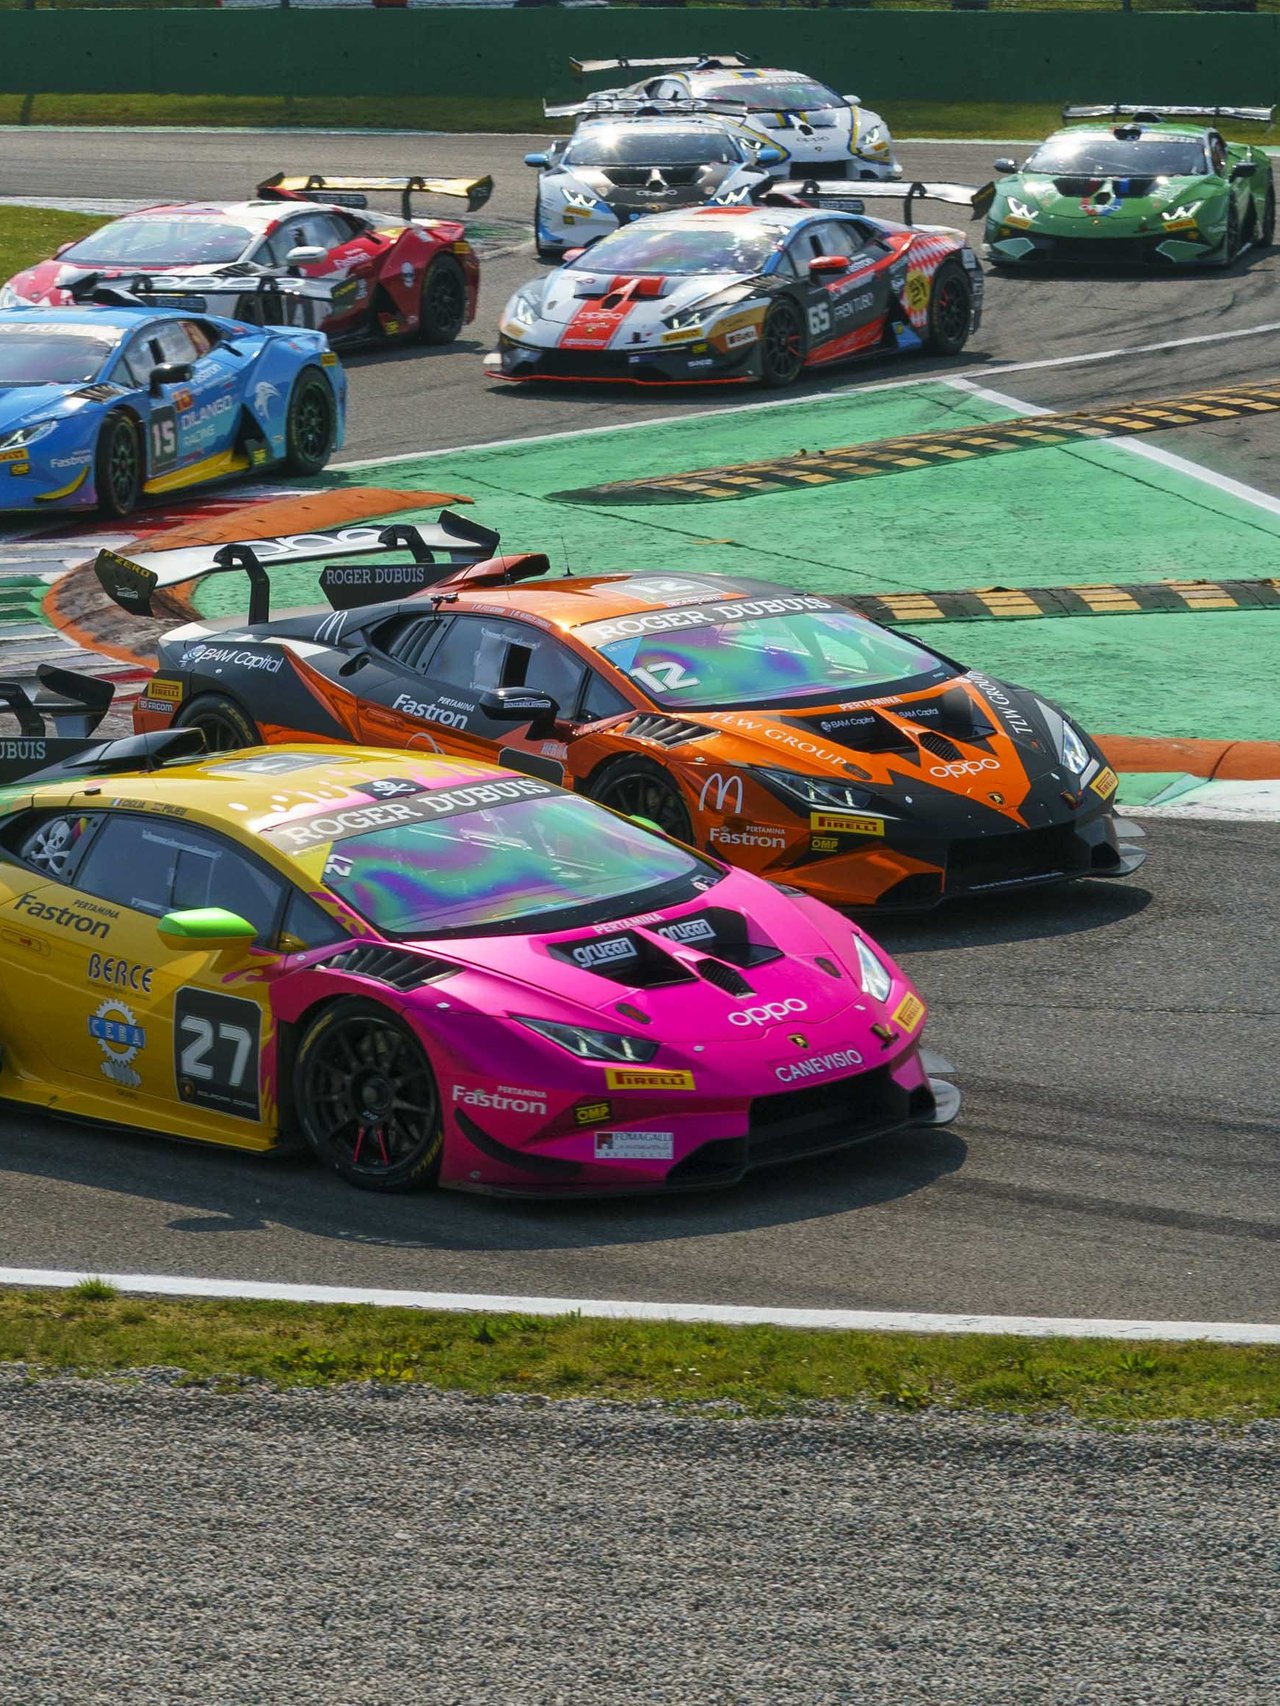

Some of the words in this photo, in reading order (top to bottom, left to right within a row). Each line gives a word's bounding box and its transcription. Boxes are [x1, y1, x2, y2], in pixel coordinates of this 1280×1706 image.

[578, 311, 622, 320] oppo
[808, 302, 830, 335] 65
[152, 419, 176, 457] 15
[115, 556, 151, 579] ZERO
[326, 568, 372, 585] ROGER
[375, 567, 425, 584] DUBUIS
[592, 609, 716, 640] ROGER
[711, 596, 833, 620] DUBUIS
[198, 648, 233, 664] BAM
[234, 651, 285, 674] Capital
[630, 661, 701, 694] 12
[152, 684, 180, 698] PIRELLI
[839, 694, 904, 712] PERTAMINA
[392, 693, 468, 730] Fastron
[437, 695, 476, 713] PERTAMINA
[831, 719, 850, 729] BAM
[851, 716, 876, 728] Capital
[916, 706, 940, 717] Capital
[708, 711, 763, 731] TLW
[764, 728, 848, 767] GROUP
[929, 756, 1001, 779] oppo
[279, 801, 424, 847] ROGER
[416, 778, 554, 817] DUBUIS
[818, 815, 878, 832] PIRELLI
[709, 827, 786, 849] Fastron
[746, 825, 786, 836] PERTAMINA
[812, 838, 840, 850] OMP
[324, 853, 354, 880] 27
[13, 892, 111, 939] Fastron
[72, 899, 120, 919] PERTAMINA
[591, 912, 666, 935] PERTAMINA
[572, 938, 636, 968] grucar
[88, 952, 154, 993] BERCE
[727, 997, 809, 1027] oppo
[898, 996, 920, 1026] PIRELLI
[180, 1014, 253, 1088] 27
[775, 1048, 864, 1083] CANEVISIO
[497, 1085, 548, 1099] PERTAMINA
[614, 1072, 686, 1086] PIRELLI
[452, 1085, 547, 1115] Fastron
[577, 1106, 609, 1121] OMP
